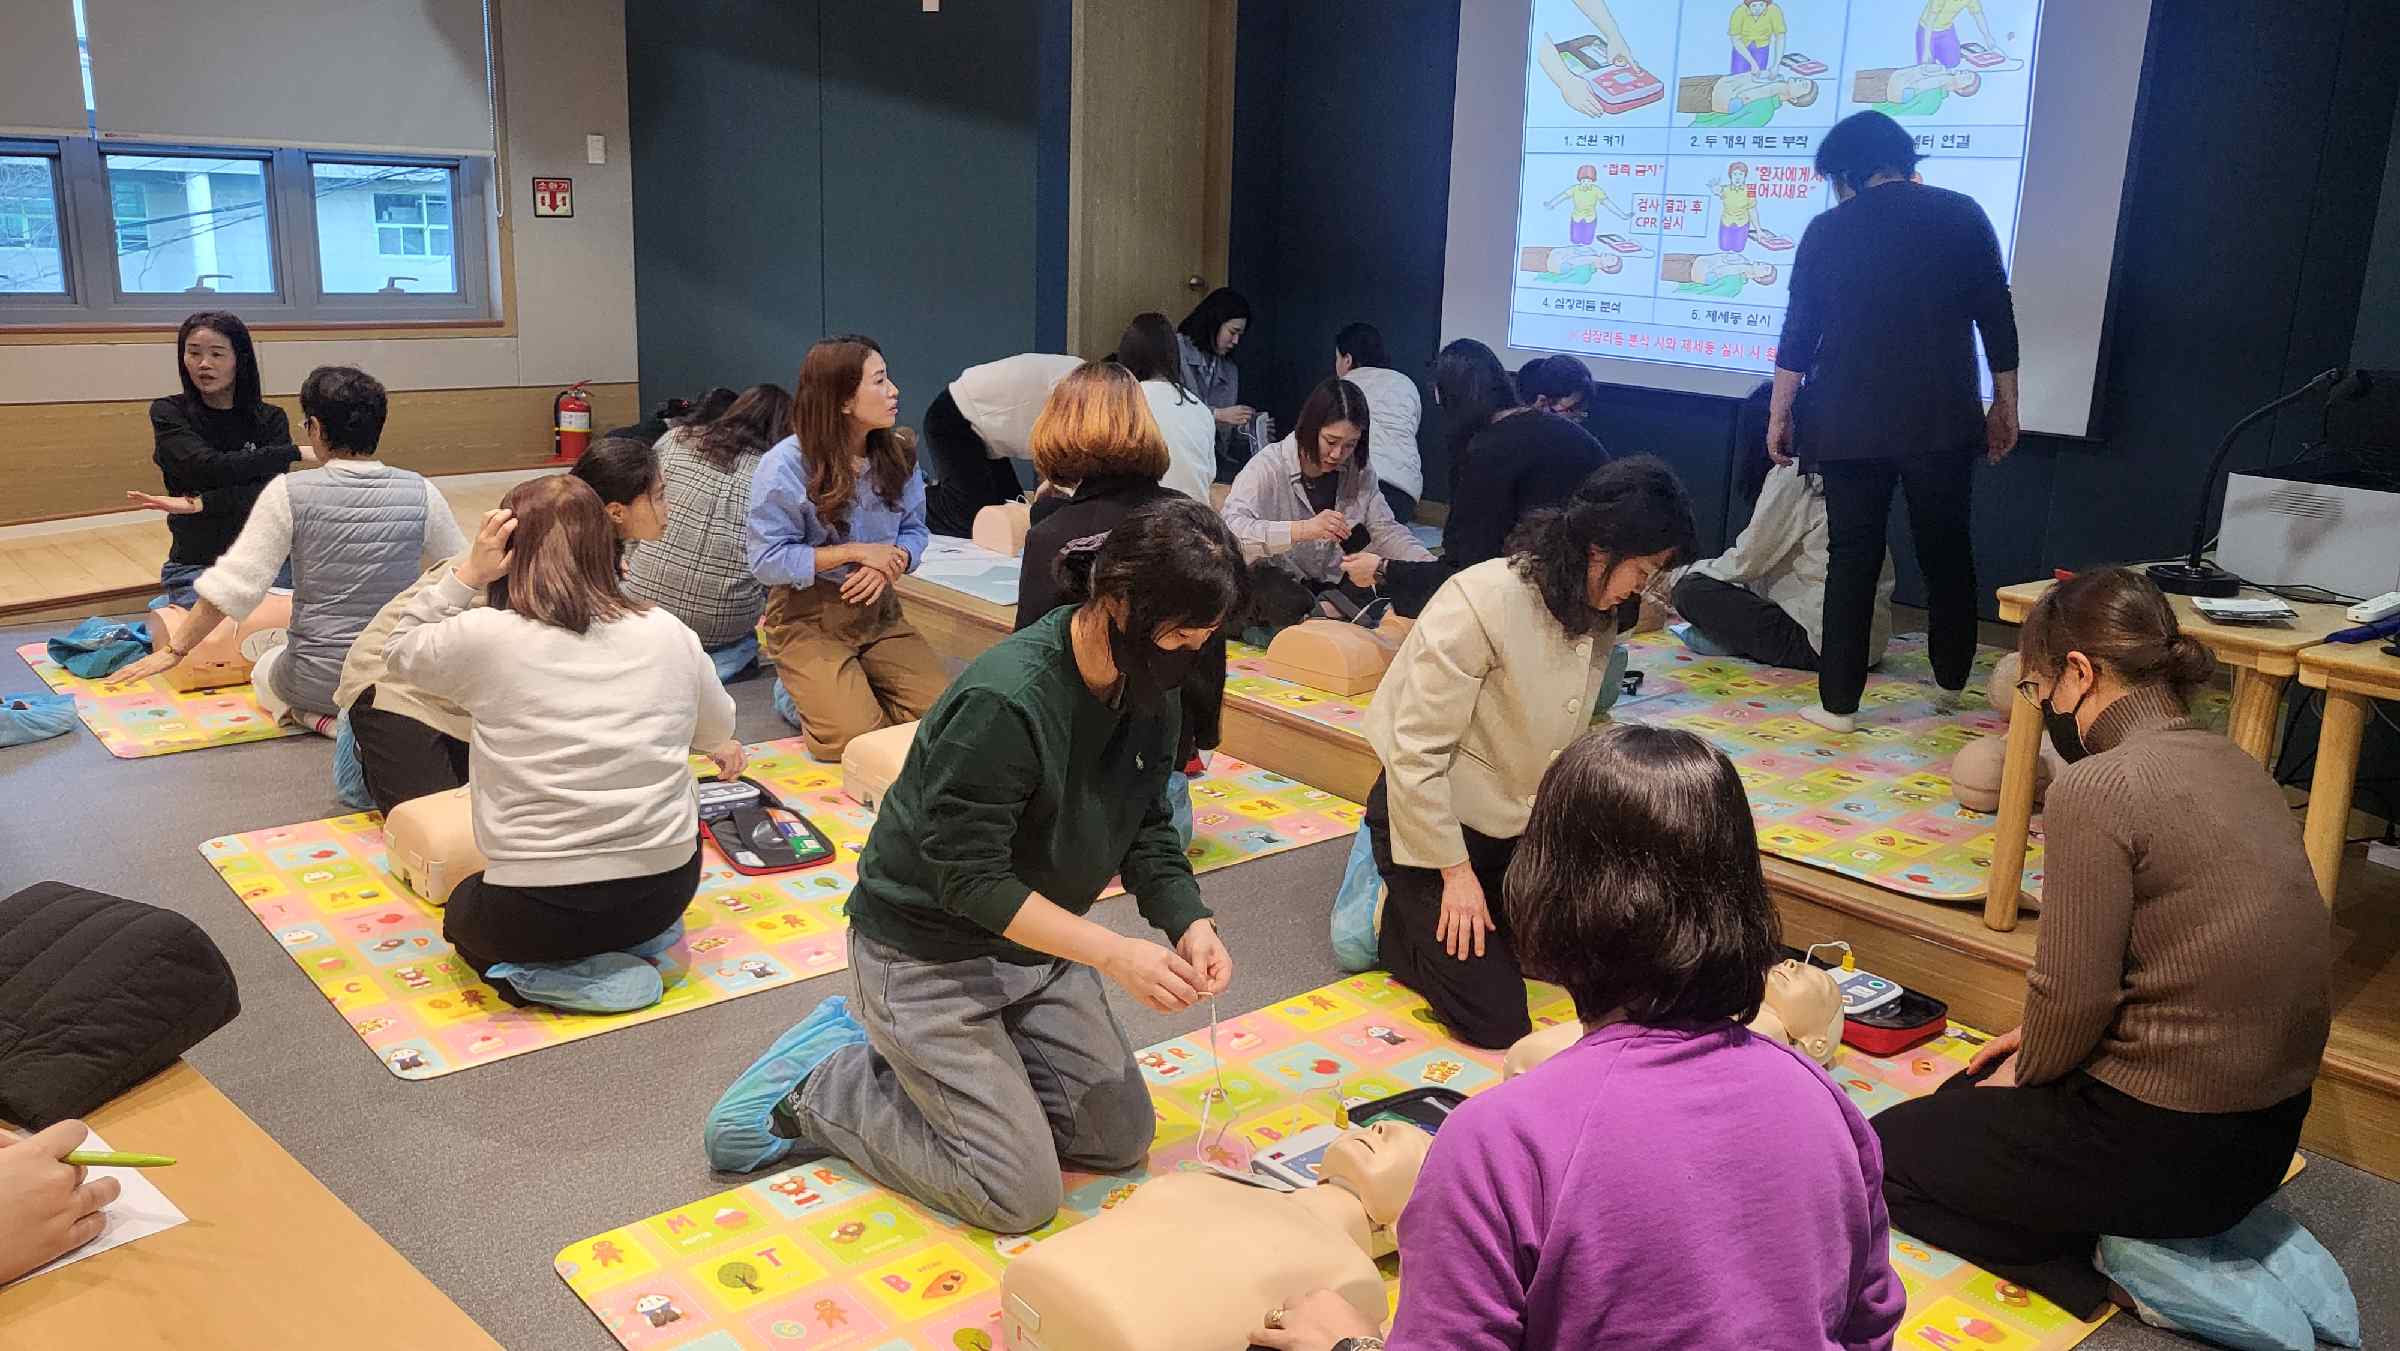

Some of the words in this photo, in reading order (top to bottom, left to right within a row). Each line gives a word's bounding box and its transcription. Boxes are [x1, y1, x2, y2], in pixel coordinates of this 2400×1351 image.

[1705, 135, 1718, 149] 두
[1940, 134, 1970, 149] 연결
[1635, 216, 1658, 228] CPR
[666, 1213, 697, 1234] M
[755, 1247, 783, 1267] T
[1896, 1241, 1932, 1263] S
[880, 1274, 913, 1293] B
